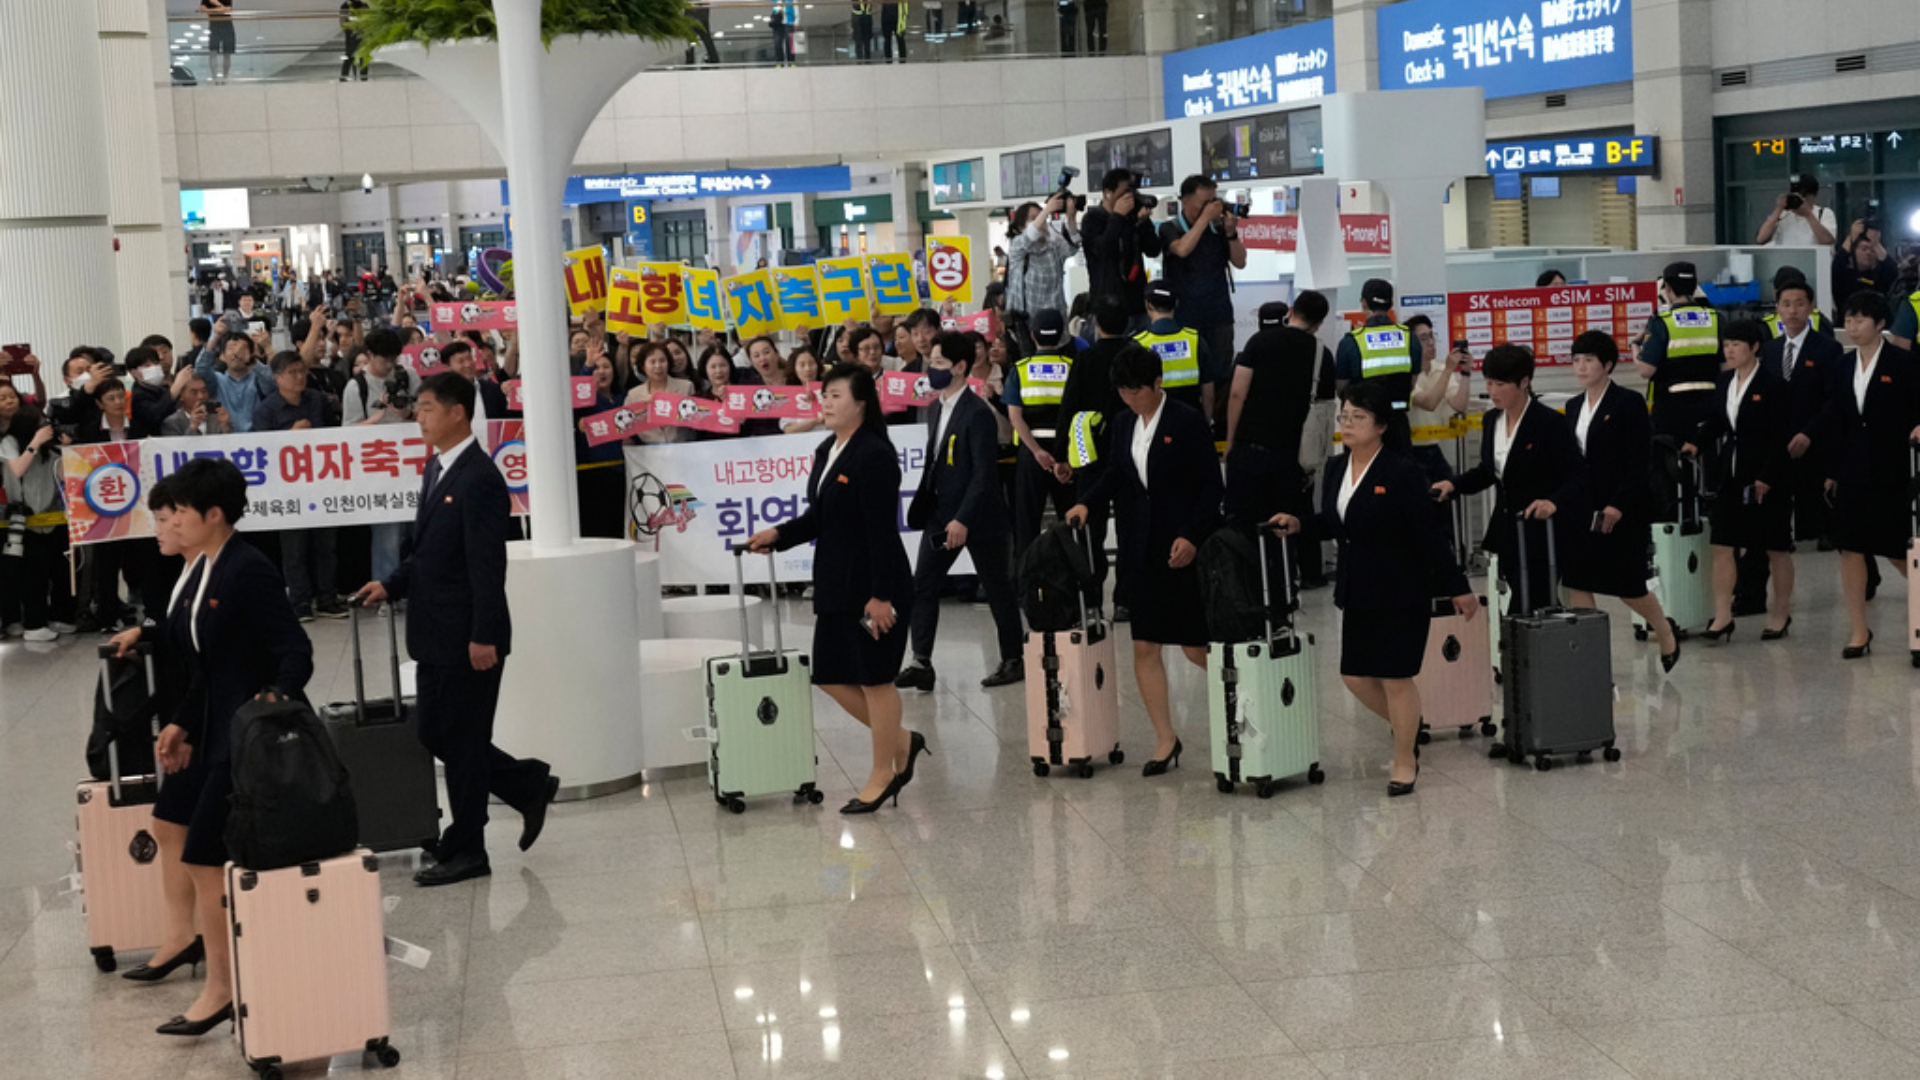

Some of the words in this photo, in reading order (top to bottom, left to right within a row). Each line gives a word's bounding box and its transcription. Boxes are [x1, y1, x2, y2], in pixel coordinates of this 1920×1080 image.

[1403, 23, 1446, 52] Domestic
[1452, 12, 1535, 70] 국내선수속
[1405, 57, 1446, 84] Check-in
[1606, 139, 1643, 164] B-F
[632, 205, 646, 223] B
[563, 255, 607, 304] 내
[823, 266, 865, 312] 구
[871, 262, 912, 304] 단
[931, 251, 963, 287] 영
[608, 280, 646, 325] 고
[640, 272, 683, 314] 향
[683, 278, 722, 321] 녀
[729, 279, 774, 326] 자
[777, 277, 819, 317] 축
[1469, 295, 1490, 310] SK
[1492, 297, 1540, 308] telecom
[1550, 289, 1591, 305] eSIM
[1605, 287, 1635, 301] SIM
[278, 441, 354, 483] 여자
[503, 452, 528, 482] 영
[98, 475, 127, 504] 환
[240, 498, 301, 518] 체육회
